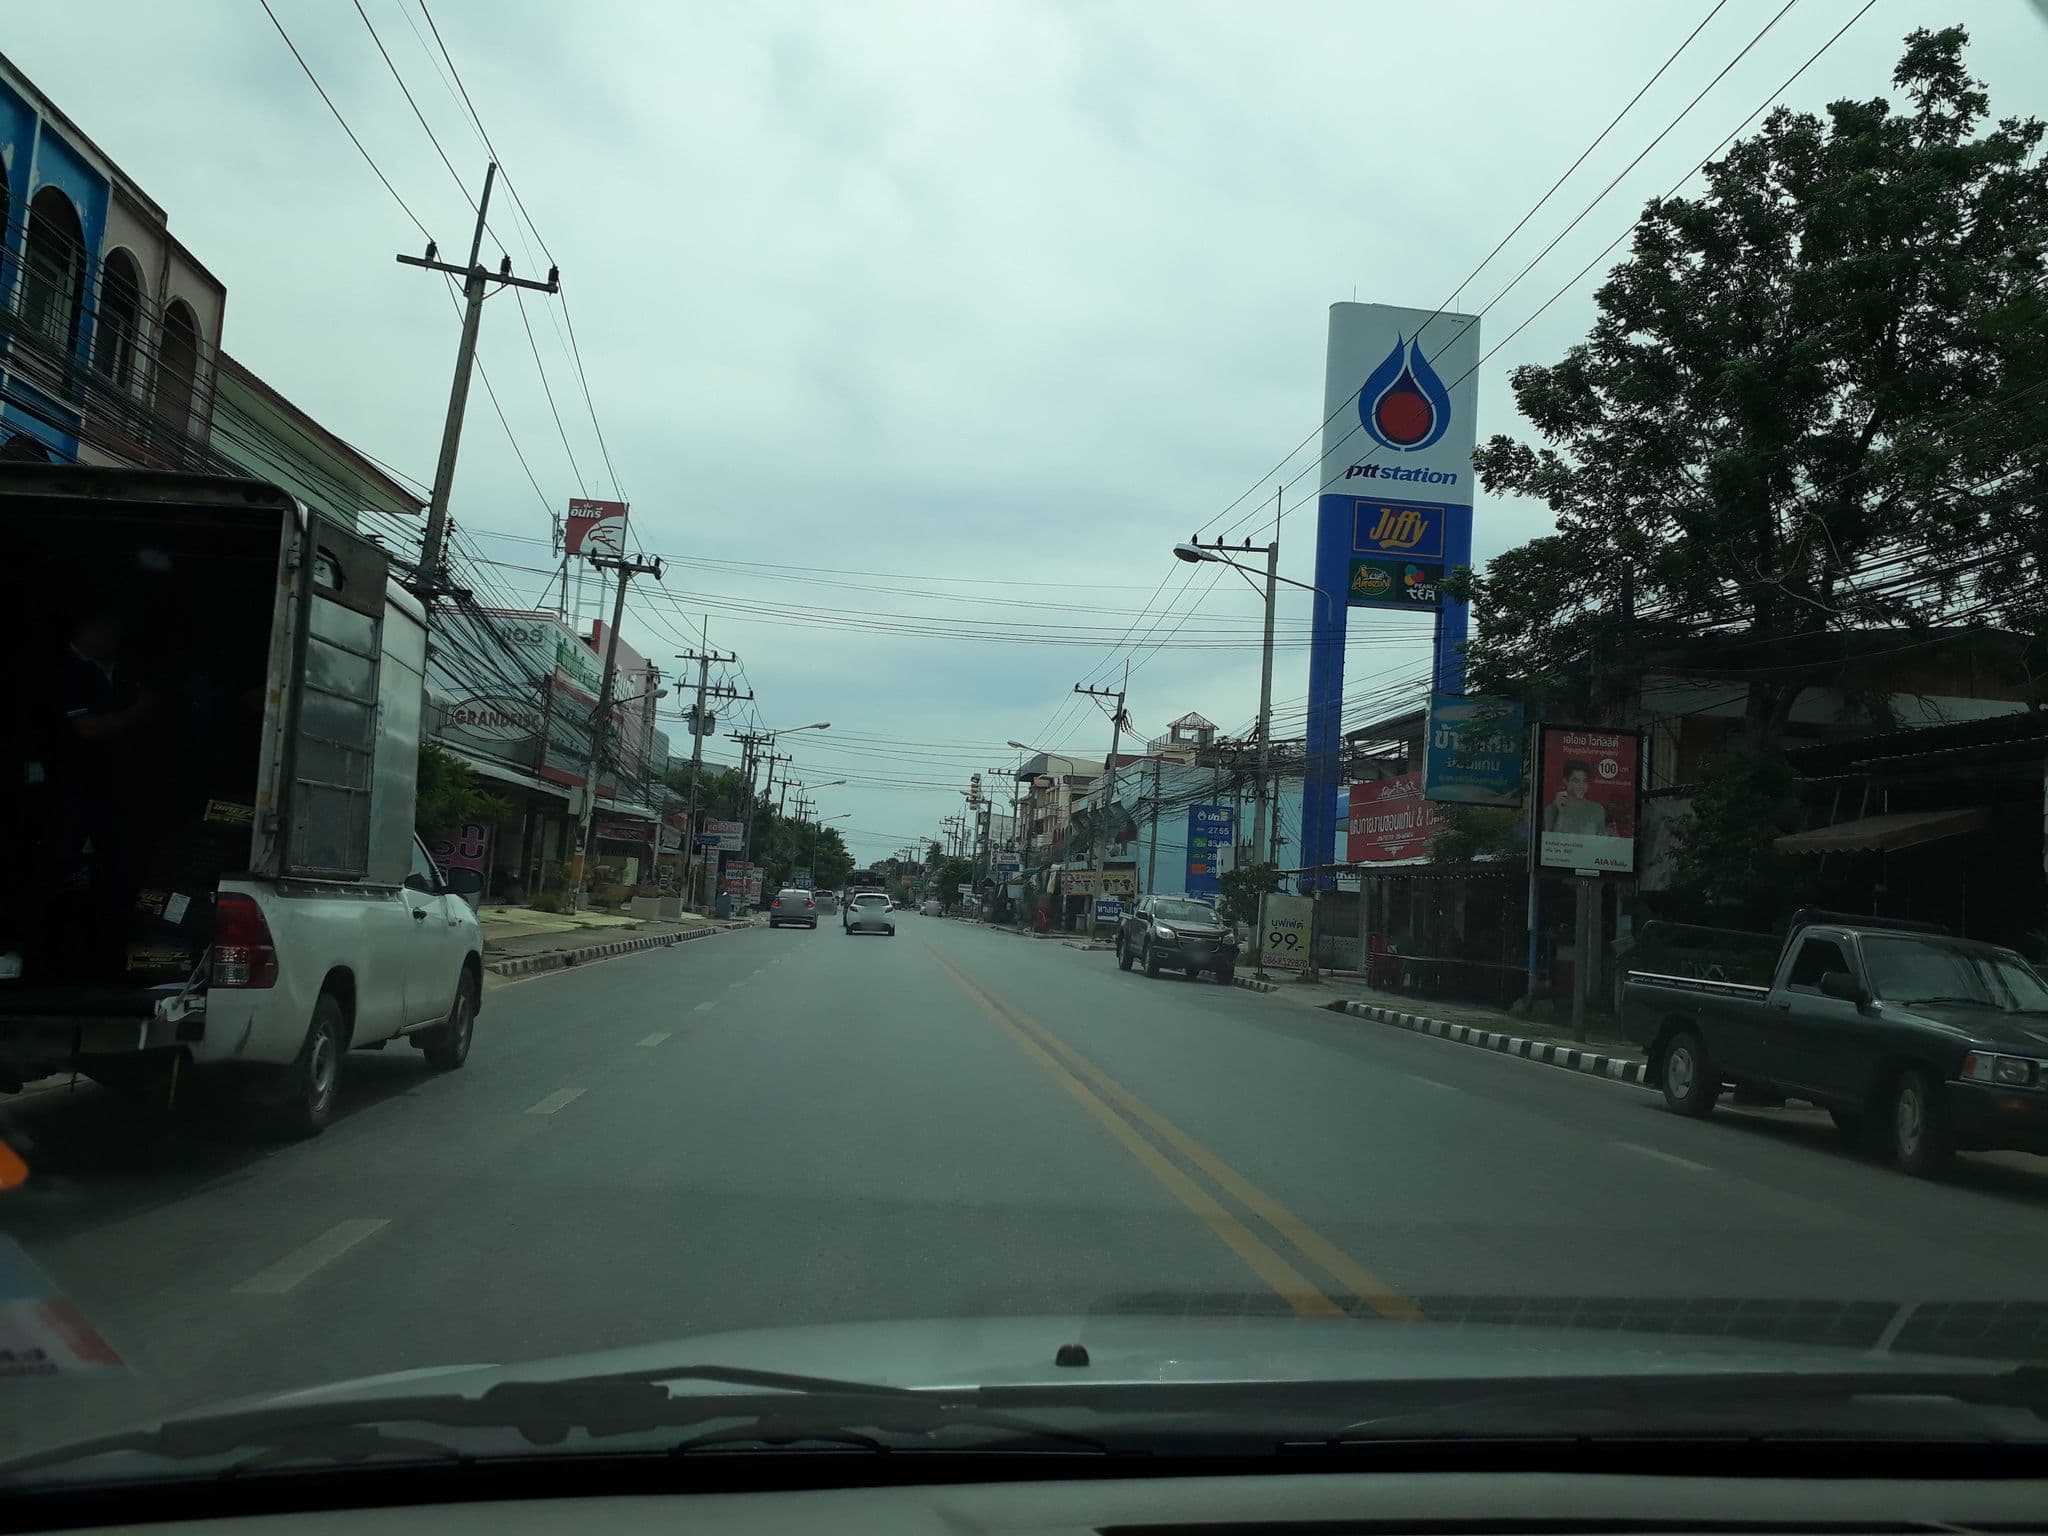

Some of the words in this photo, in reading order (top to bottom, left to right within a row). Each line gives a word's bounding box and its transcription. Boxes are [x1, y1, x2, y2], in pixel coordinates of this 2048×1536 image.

[1345, 463, 1380, 480] ptt
[1380, 465, 1458, 486] station
[1369, 507, 1430, 550] Jiffy
[1600, 763, 1617, 774] 100
[1417, 806, 1423, 828] &
[1594, 857, 1609, 866] AIA
